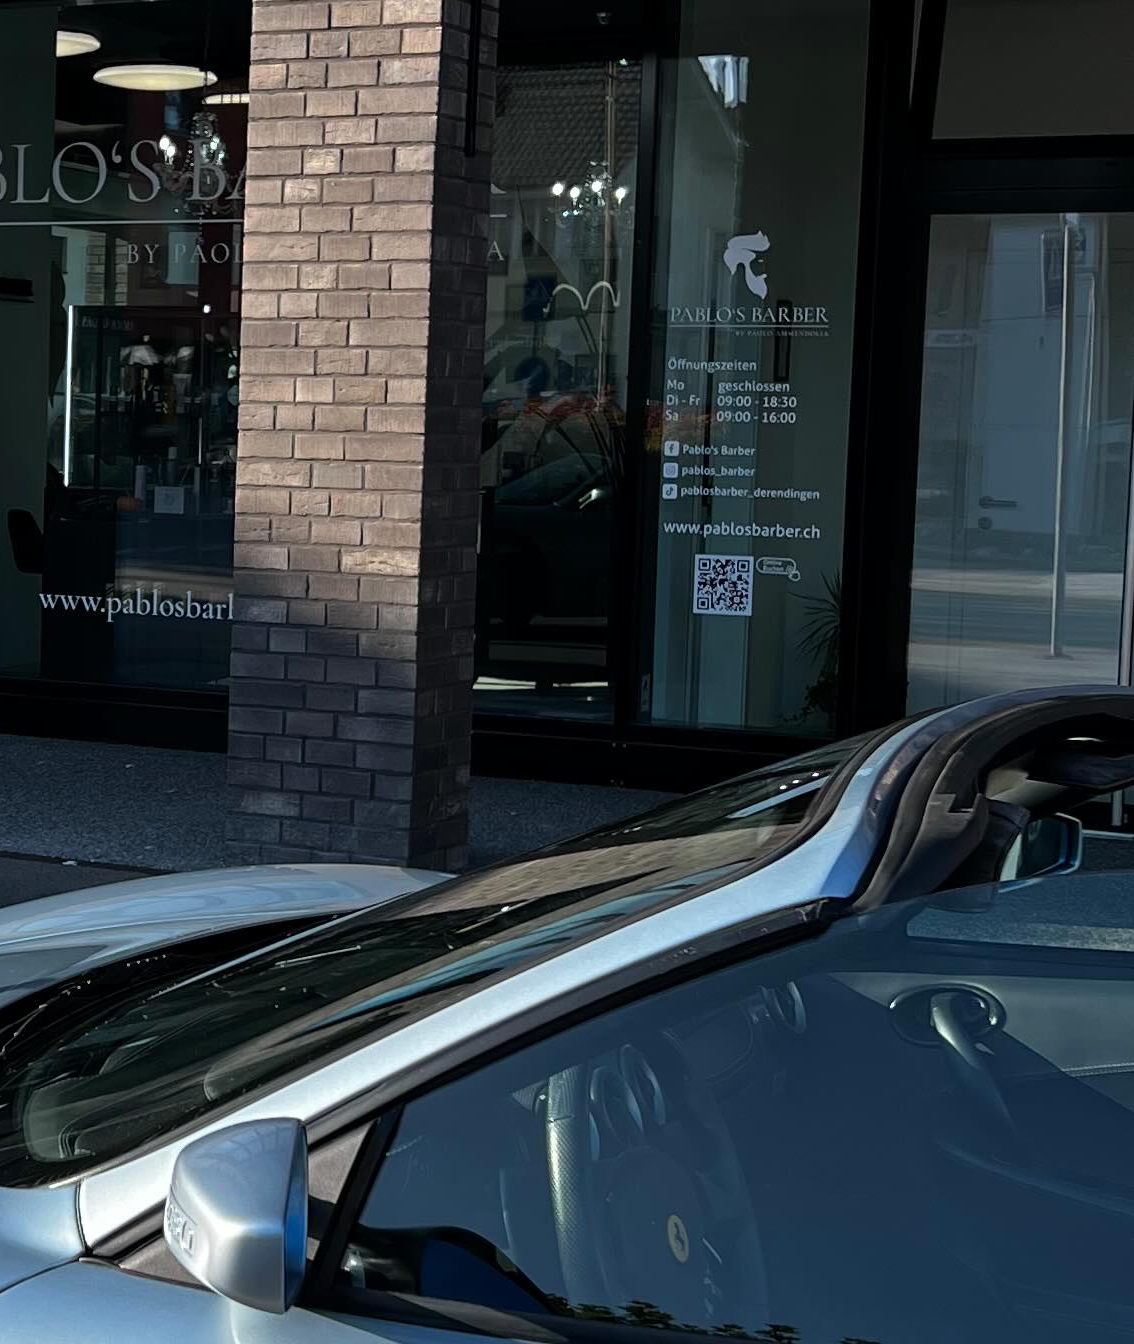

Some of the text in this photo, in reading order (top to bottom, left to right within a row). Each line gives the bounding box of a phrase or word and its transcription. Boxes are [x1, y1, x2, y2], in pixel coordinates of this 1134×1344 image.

[127, 243, 160, 264] BY
[670, 306, 829, 323] PABLO'S BARBER
[667, 358, 757, 373] Öffnungszeiten
[666, 380, 790, 393] Mo geschlossen
[666, 394, 679, 406] Di
[689, 395, 701, 406] Fr
[717, 395, 752, 407] 09:00
[763, 396, 797, 408] 18:30
[666, 410, 679, 422] Sa
[716, 411, 751, 423] 09:00
[762, 412, 797, 424] 16:00
[682, 444, 718, 455] Pablo's
[721, 445, 756, 456] Barber
[681, 464, 756, 477] pablos_barber
[680, 485, 820, 502] pablosbarber_derendingen
[663, 521, 821, 539] www.pablosbarber.ch
